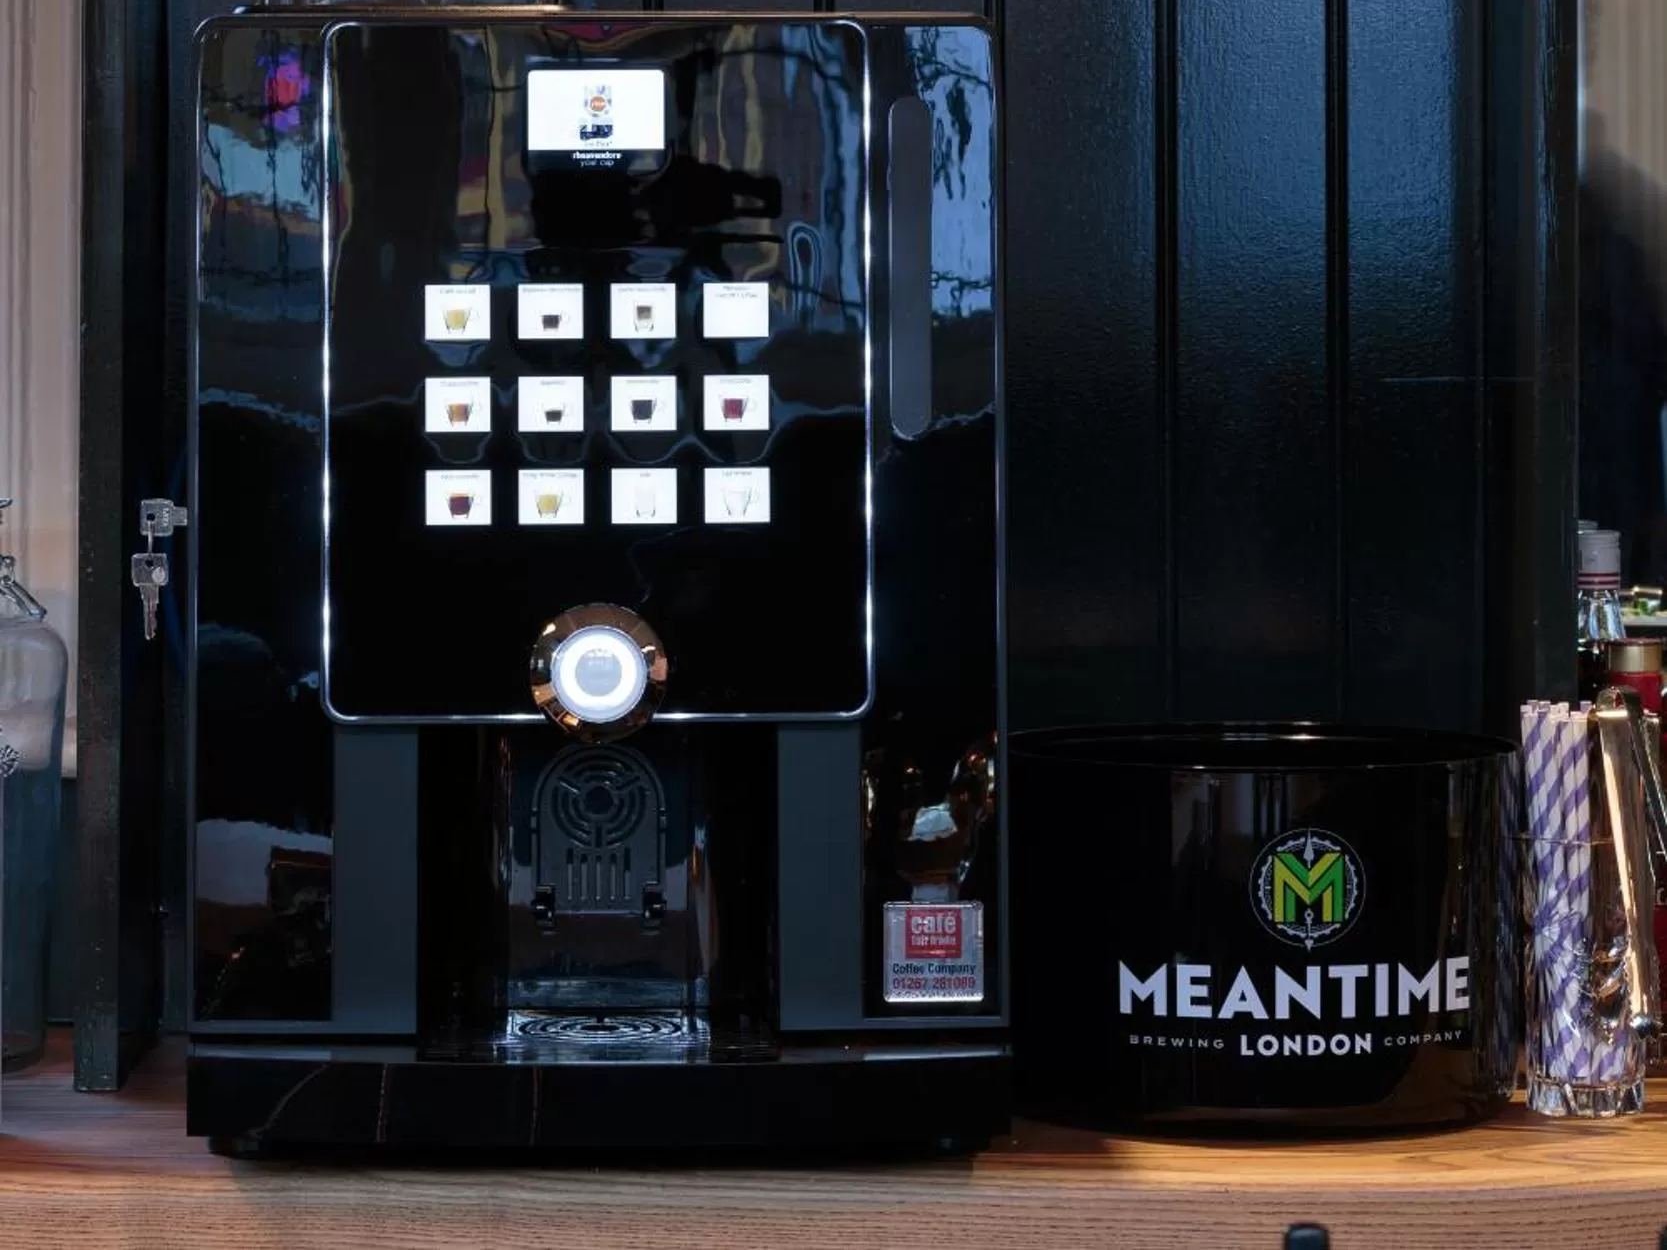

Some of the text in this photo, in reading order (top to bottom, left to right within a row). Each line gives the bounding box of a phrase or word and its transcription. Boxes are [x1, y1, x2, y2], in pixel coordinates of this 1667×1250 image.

[911, 911, 956, 934] café
[893, 963, 976, 976] Coffee Company
[1119, 956, 1470, 1020] MEANTIME
[1129, 1030, 1462, 1056] BREWING LONDON COMPANY
